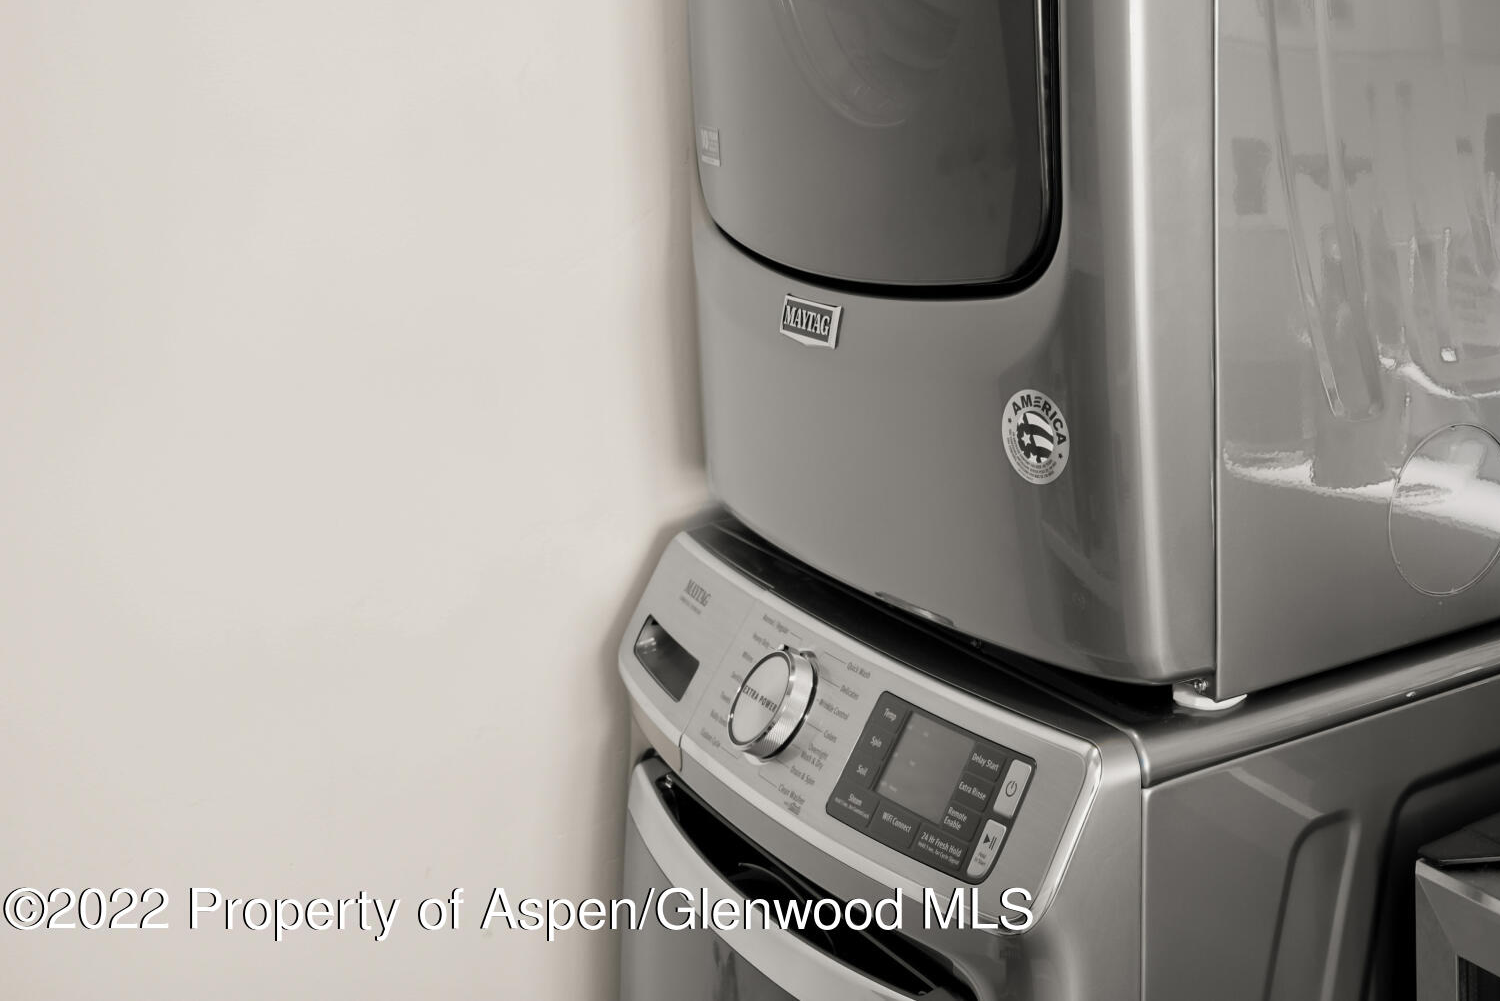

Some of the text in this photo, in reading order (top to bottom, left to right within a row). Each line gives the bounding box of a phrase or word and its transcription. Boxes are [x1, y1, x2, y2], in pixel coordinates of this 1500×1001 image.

[783, 305, 831, 336] MAYTAG
[1011, 394, 1067, 446] AMERICA
[743, 685, 760, 700] EXTRA
[759, 695, 778, 713] POWER
[971, 753, 1000, 772] Delay Start
[958, 780, 987, 801] Extra Rinse
[943, 815, 962, 831] Enable
[947, 806, 967, 822] Remote
[892, 816, 912, 834] Connect
[921, 831, 929, 841] 24
[935, 838, 950, 852] Fresh
[949, 845, 962, 857] Hold
